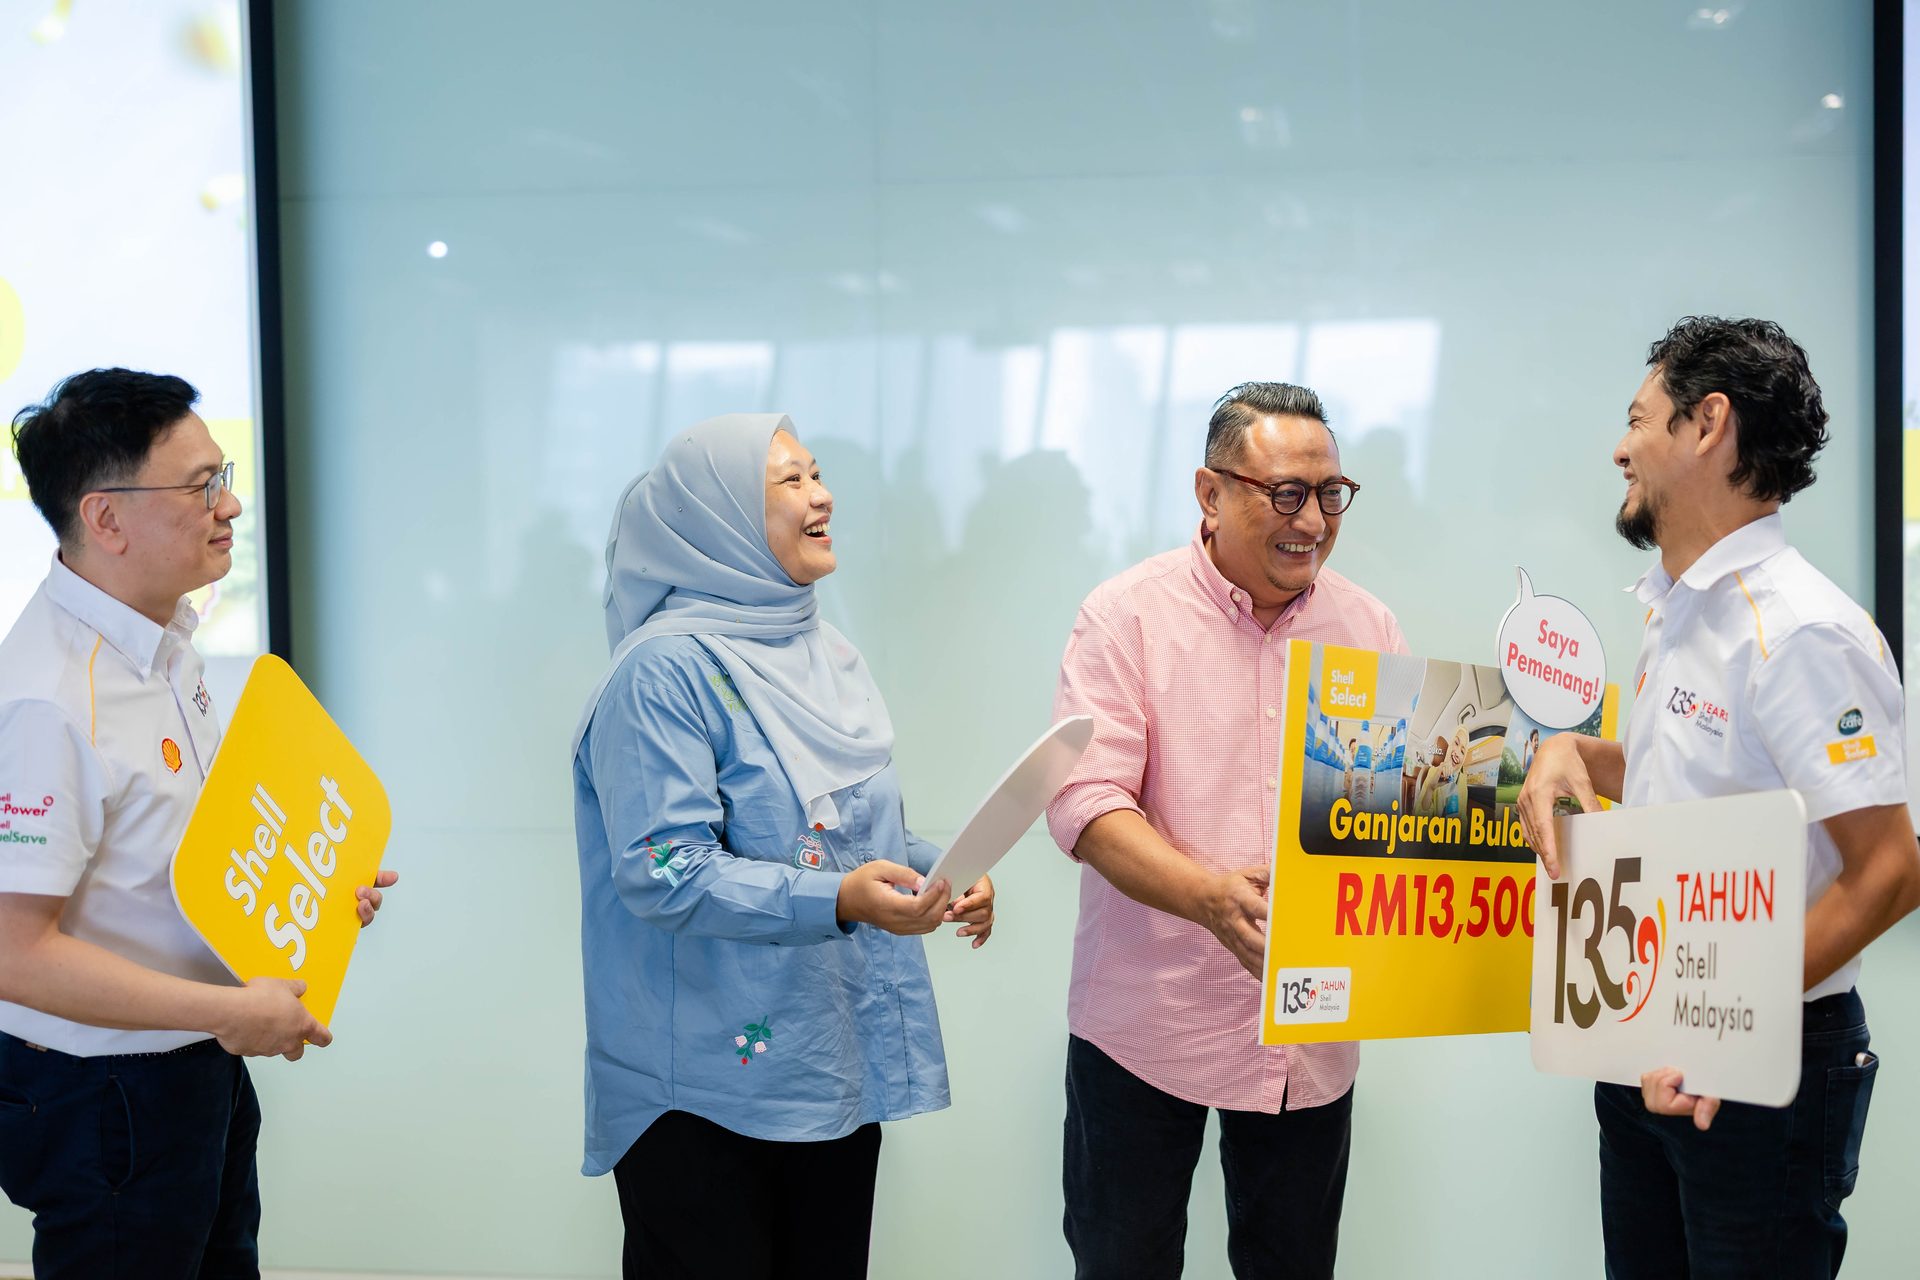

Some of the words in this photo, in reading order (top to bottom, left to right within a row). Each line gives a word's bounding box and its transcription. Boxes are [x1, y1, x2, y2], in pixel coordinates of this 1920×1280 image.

[1538, 619, 1579, 659] Saya
[1331, 669, 1355, 685] Shell
[1506, 642, 1600, 705] Pemenang!
[1330, 686, 1367, 708] Select
[1666, 686, 1696, 715] 135
[1329, 798, 1462, 855] Ganjaran
[1470, 806, 1530, 848] Bula
[224, 783, 288, 917] Shell
[264, 775, 353, 971] Select
[1677, 869, 1775, 922] TAHUN
[1551, 857, 1642, 1029] 135
[1675, 942, 1718, 981] Shell
[1282, 978, 1312, 1014] 135
[1321, 980, 1346, 991] TAHUN
[1673, 990, 1754, 1041] Malaysia
